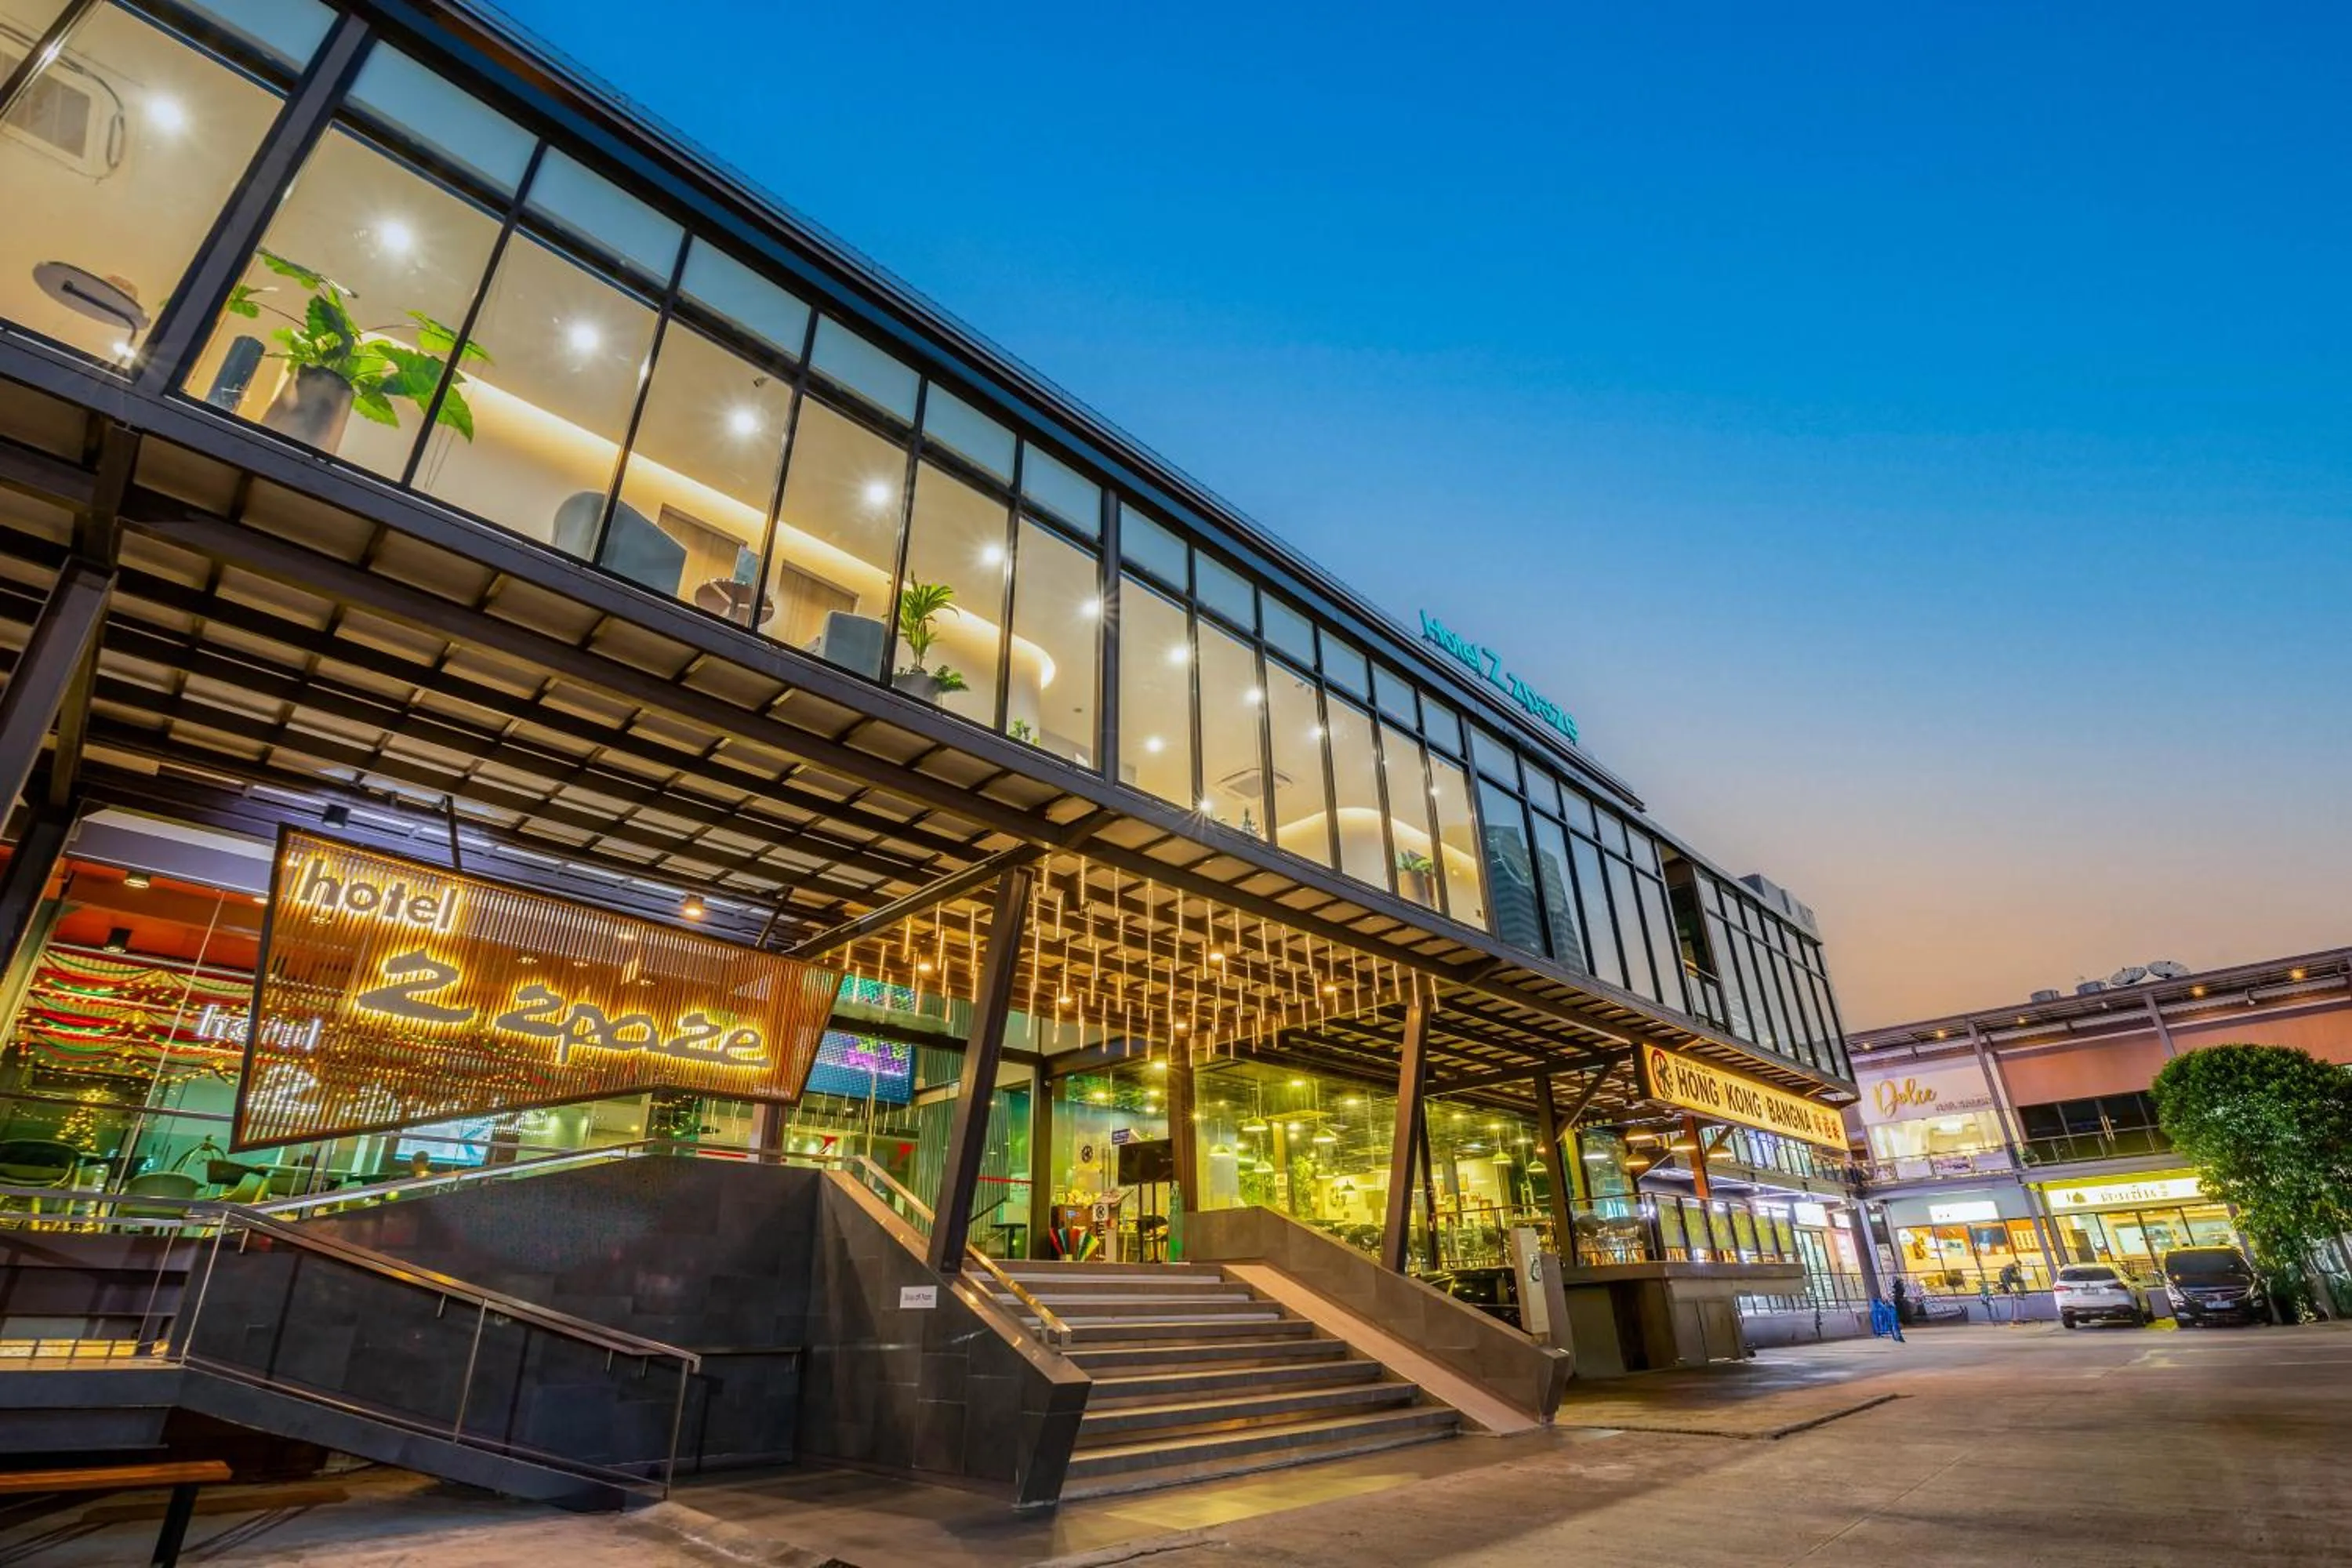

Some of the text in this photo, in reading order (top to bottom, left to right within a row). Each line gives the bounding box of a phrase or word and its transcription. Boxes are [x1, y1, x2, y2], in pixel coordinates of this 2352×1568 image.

[1419, 609, 1482, 675] Hotel
[1481, 647, 1508, 691] Z
[299, 861, 456, 930] hotel
[1675, 1065, 1720, 1107] HONG
[1725, 1082, 1763, 1119] KONG
[1766, 1095, 1813, 1134] BANGNA
